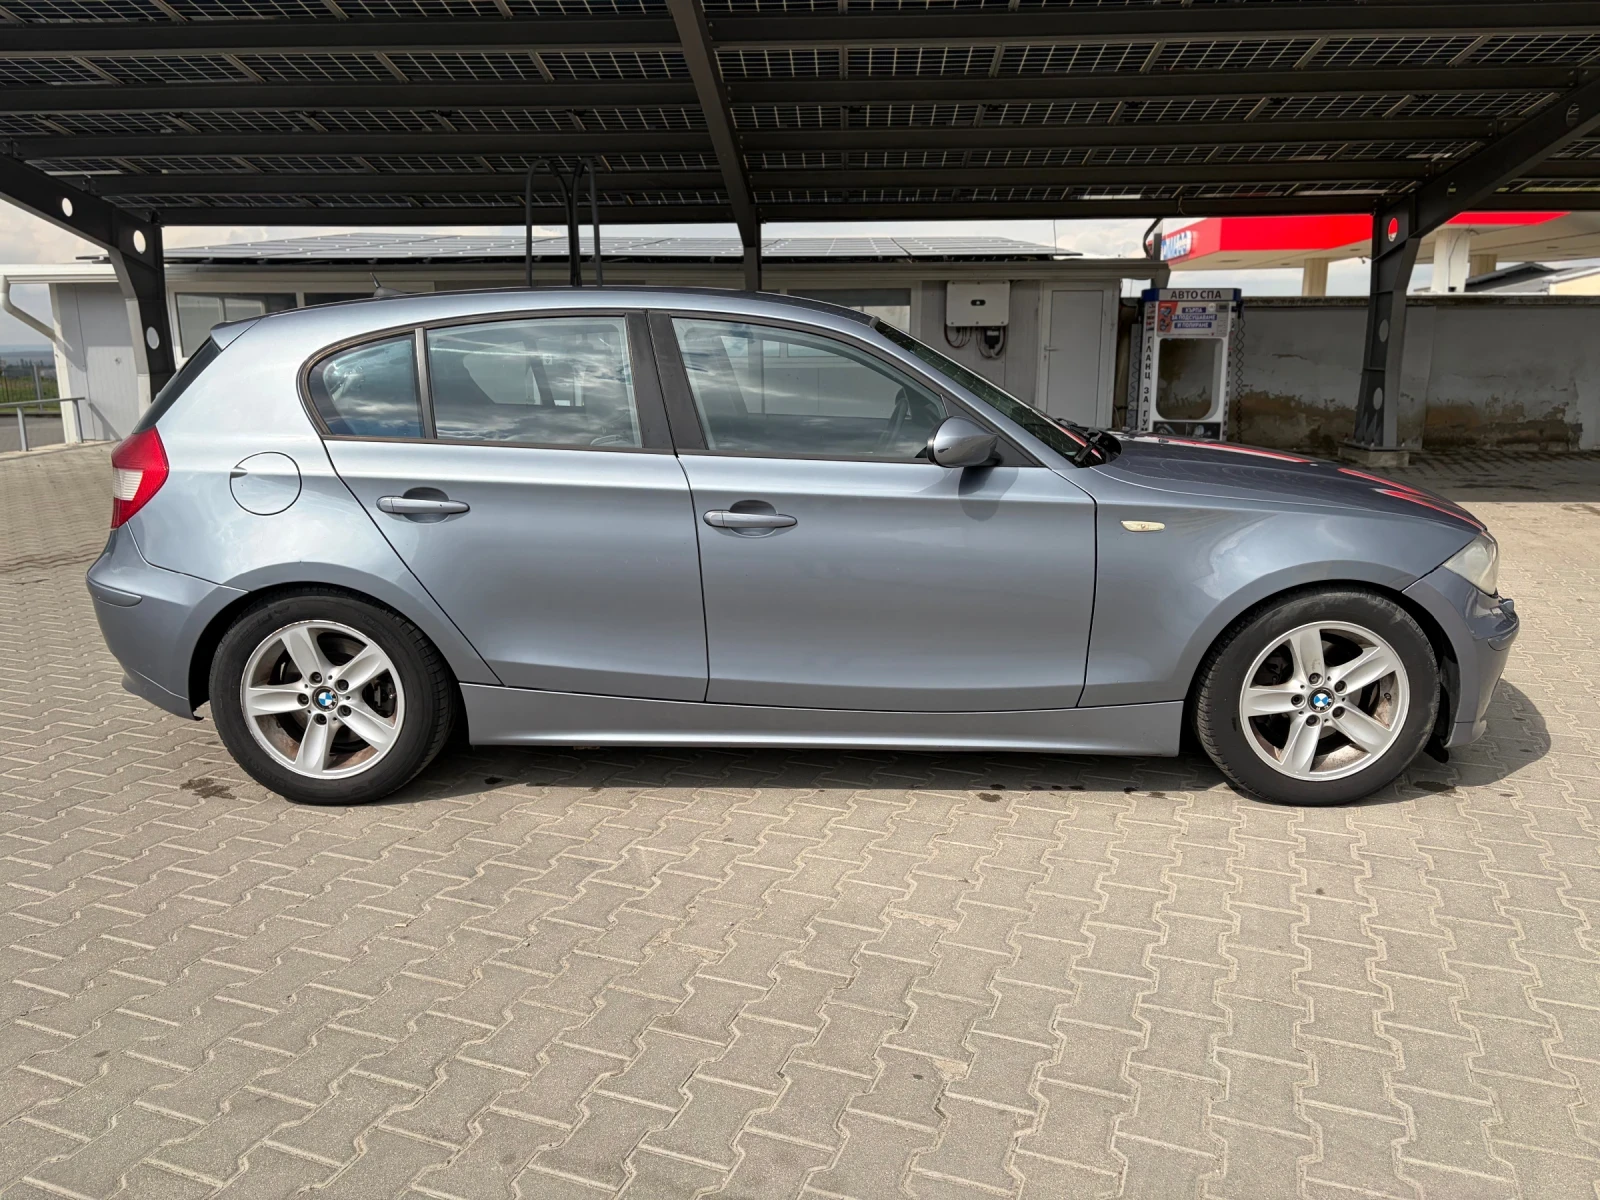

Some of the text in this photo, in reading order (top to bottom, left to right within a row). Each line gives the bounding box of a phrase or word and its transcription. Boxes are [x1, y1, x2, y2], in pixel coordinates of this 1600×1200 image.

[1170, 290, 1222, 299] АВТО СПА
[1143, 387, 1150, 403] ЗА
